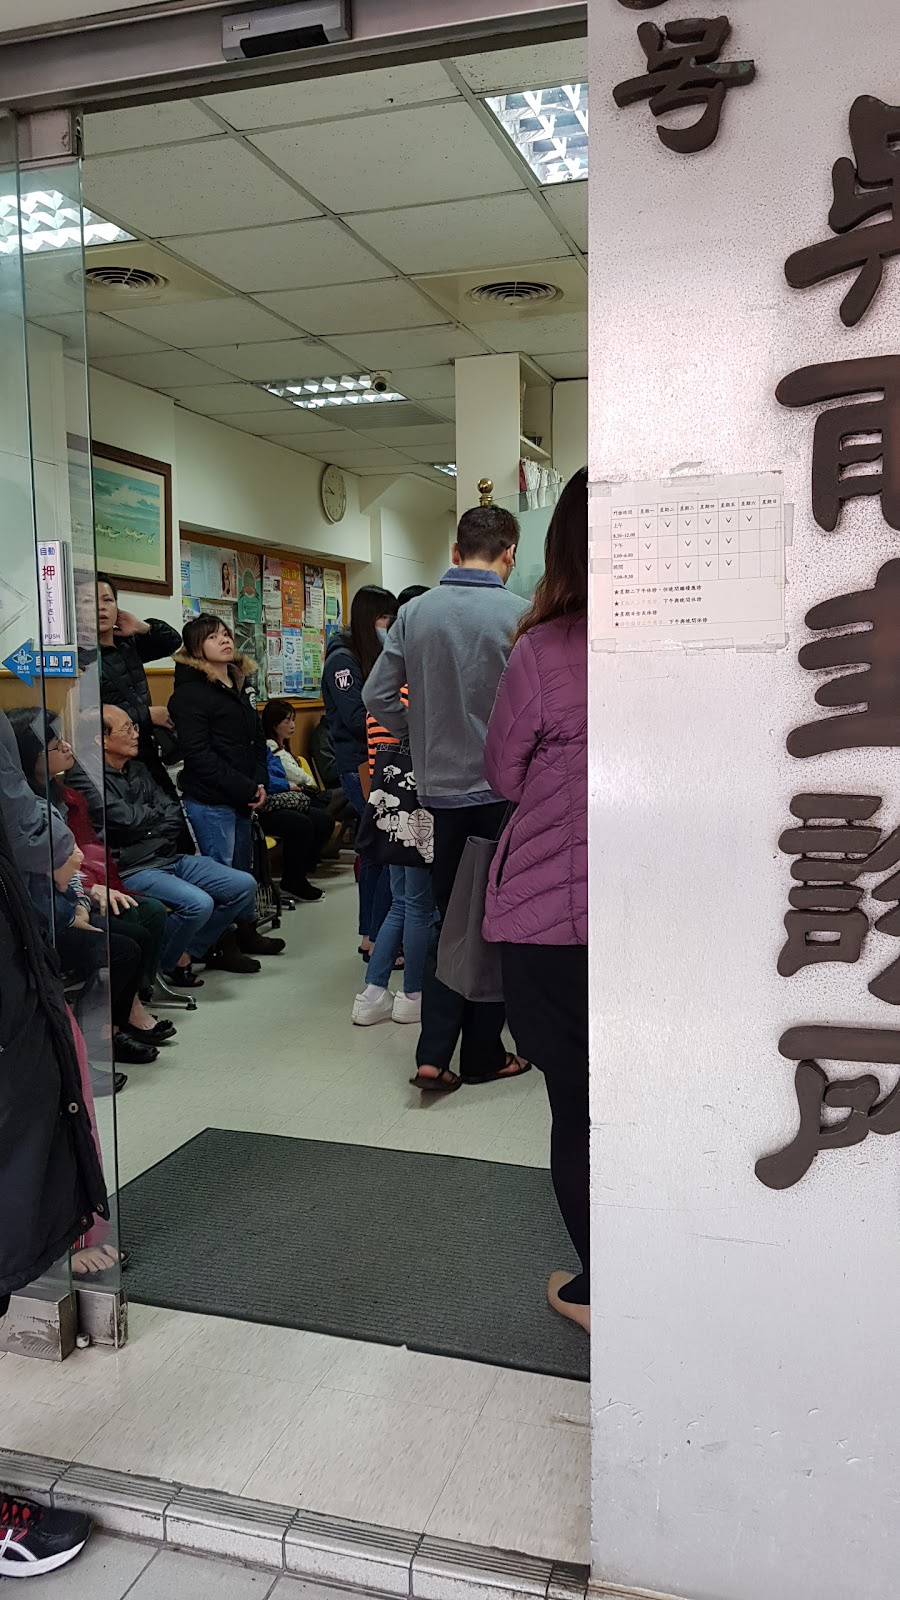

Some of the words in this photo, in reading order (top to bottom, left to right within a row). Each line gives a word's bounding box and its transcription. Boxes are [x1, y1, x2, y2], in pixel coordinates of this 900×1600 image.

[613, 0, 755, 154] 号
[40, 546, 56, 556] 自動
[35, 655, 72, 667] 自動門
